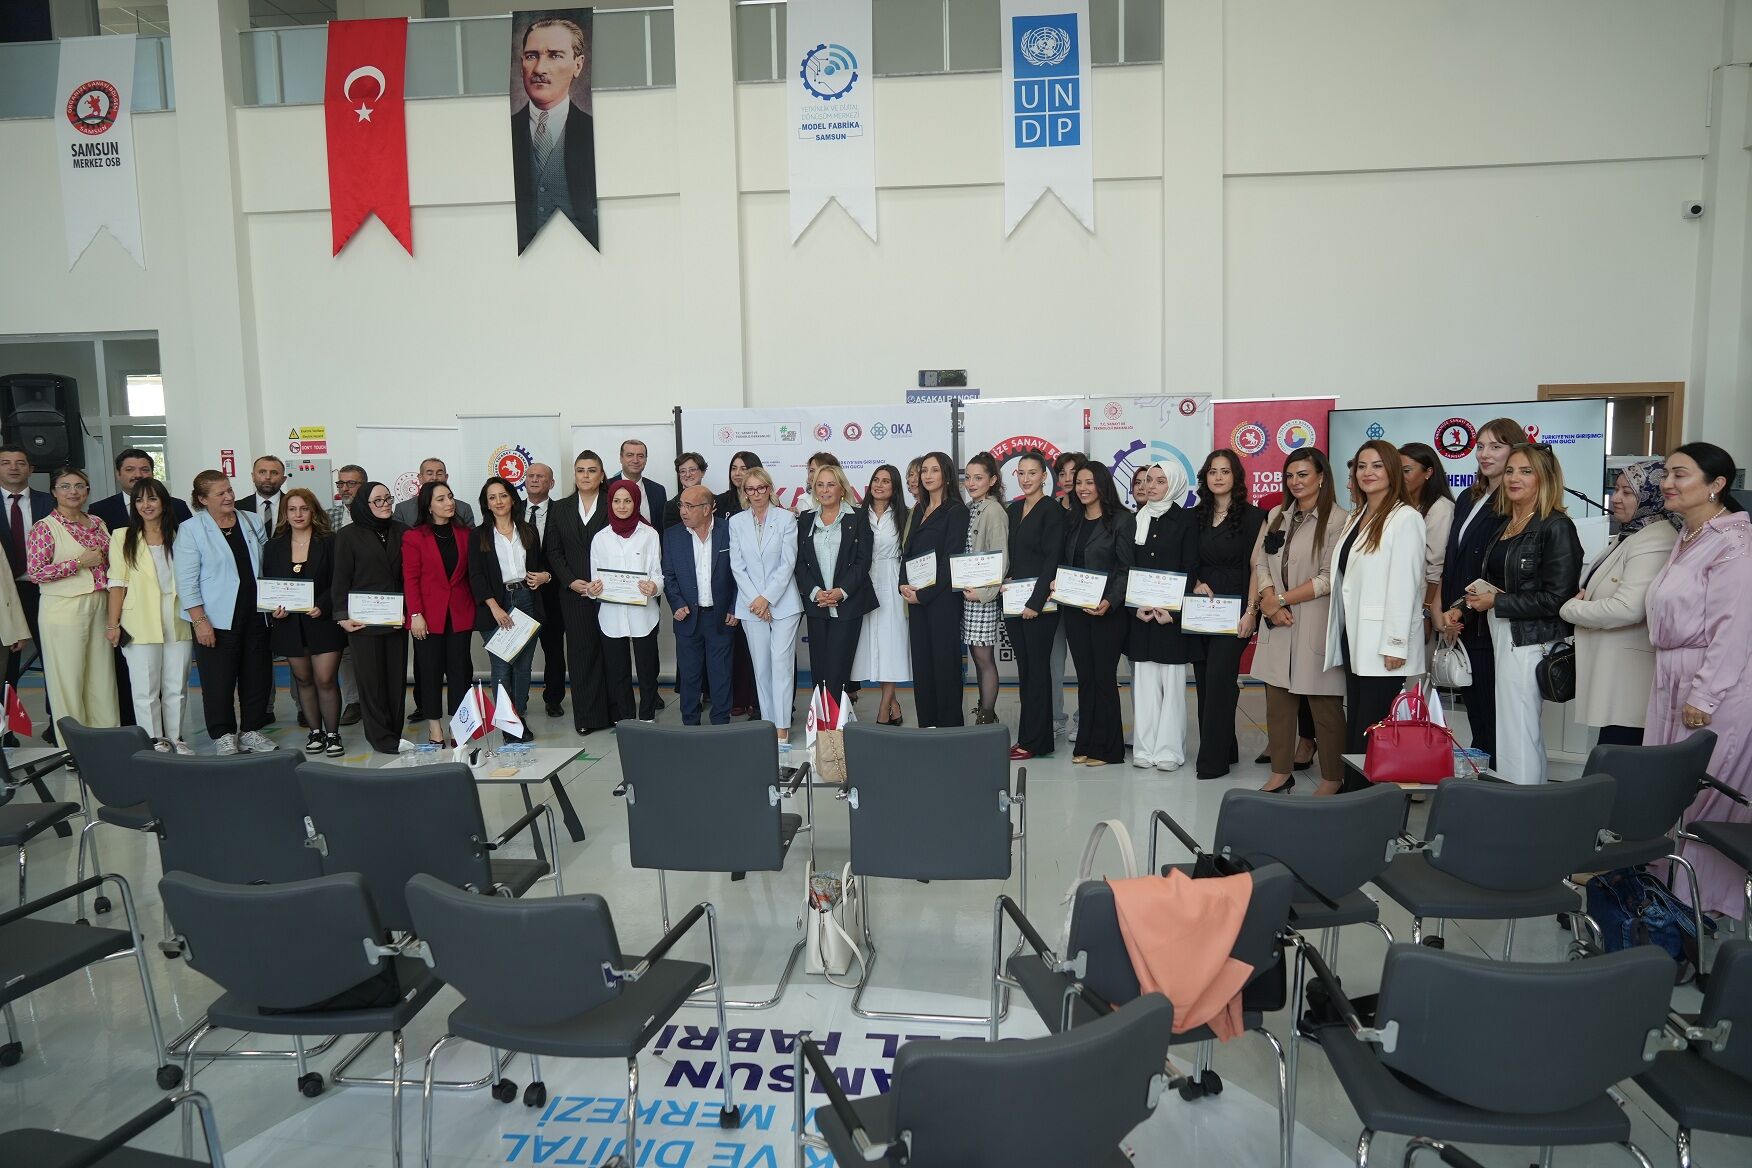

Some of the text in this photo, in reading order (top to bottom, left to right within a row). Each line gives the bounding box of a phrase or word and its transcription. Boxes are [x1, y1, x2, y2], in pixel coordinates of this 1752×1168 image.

[79, 125, 107, 135] SAMSUN
[801, 120, 860, 131] MODEL FABRİKA
[815, 133, 847, 141] SAMSUN
[71, 142, 119, 157] SAMSUN
[73, 157, 121, 169] MERKEZ OSB
[890, 423, 913, 434] OKA
[1011, 438, 1048, 451] SANAYİ
